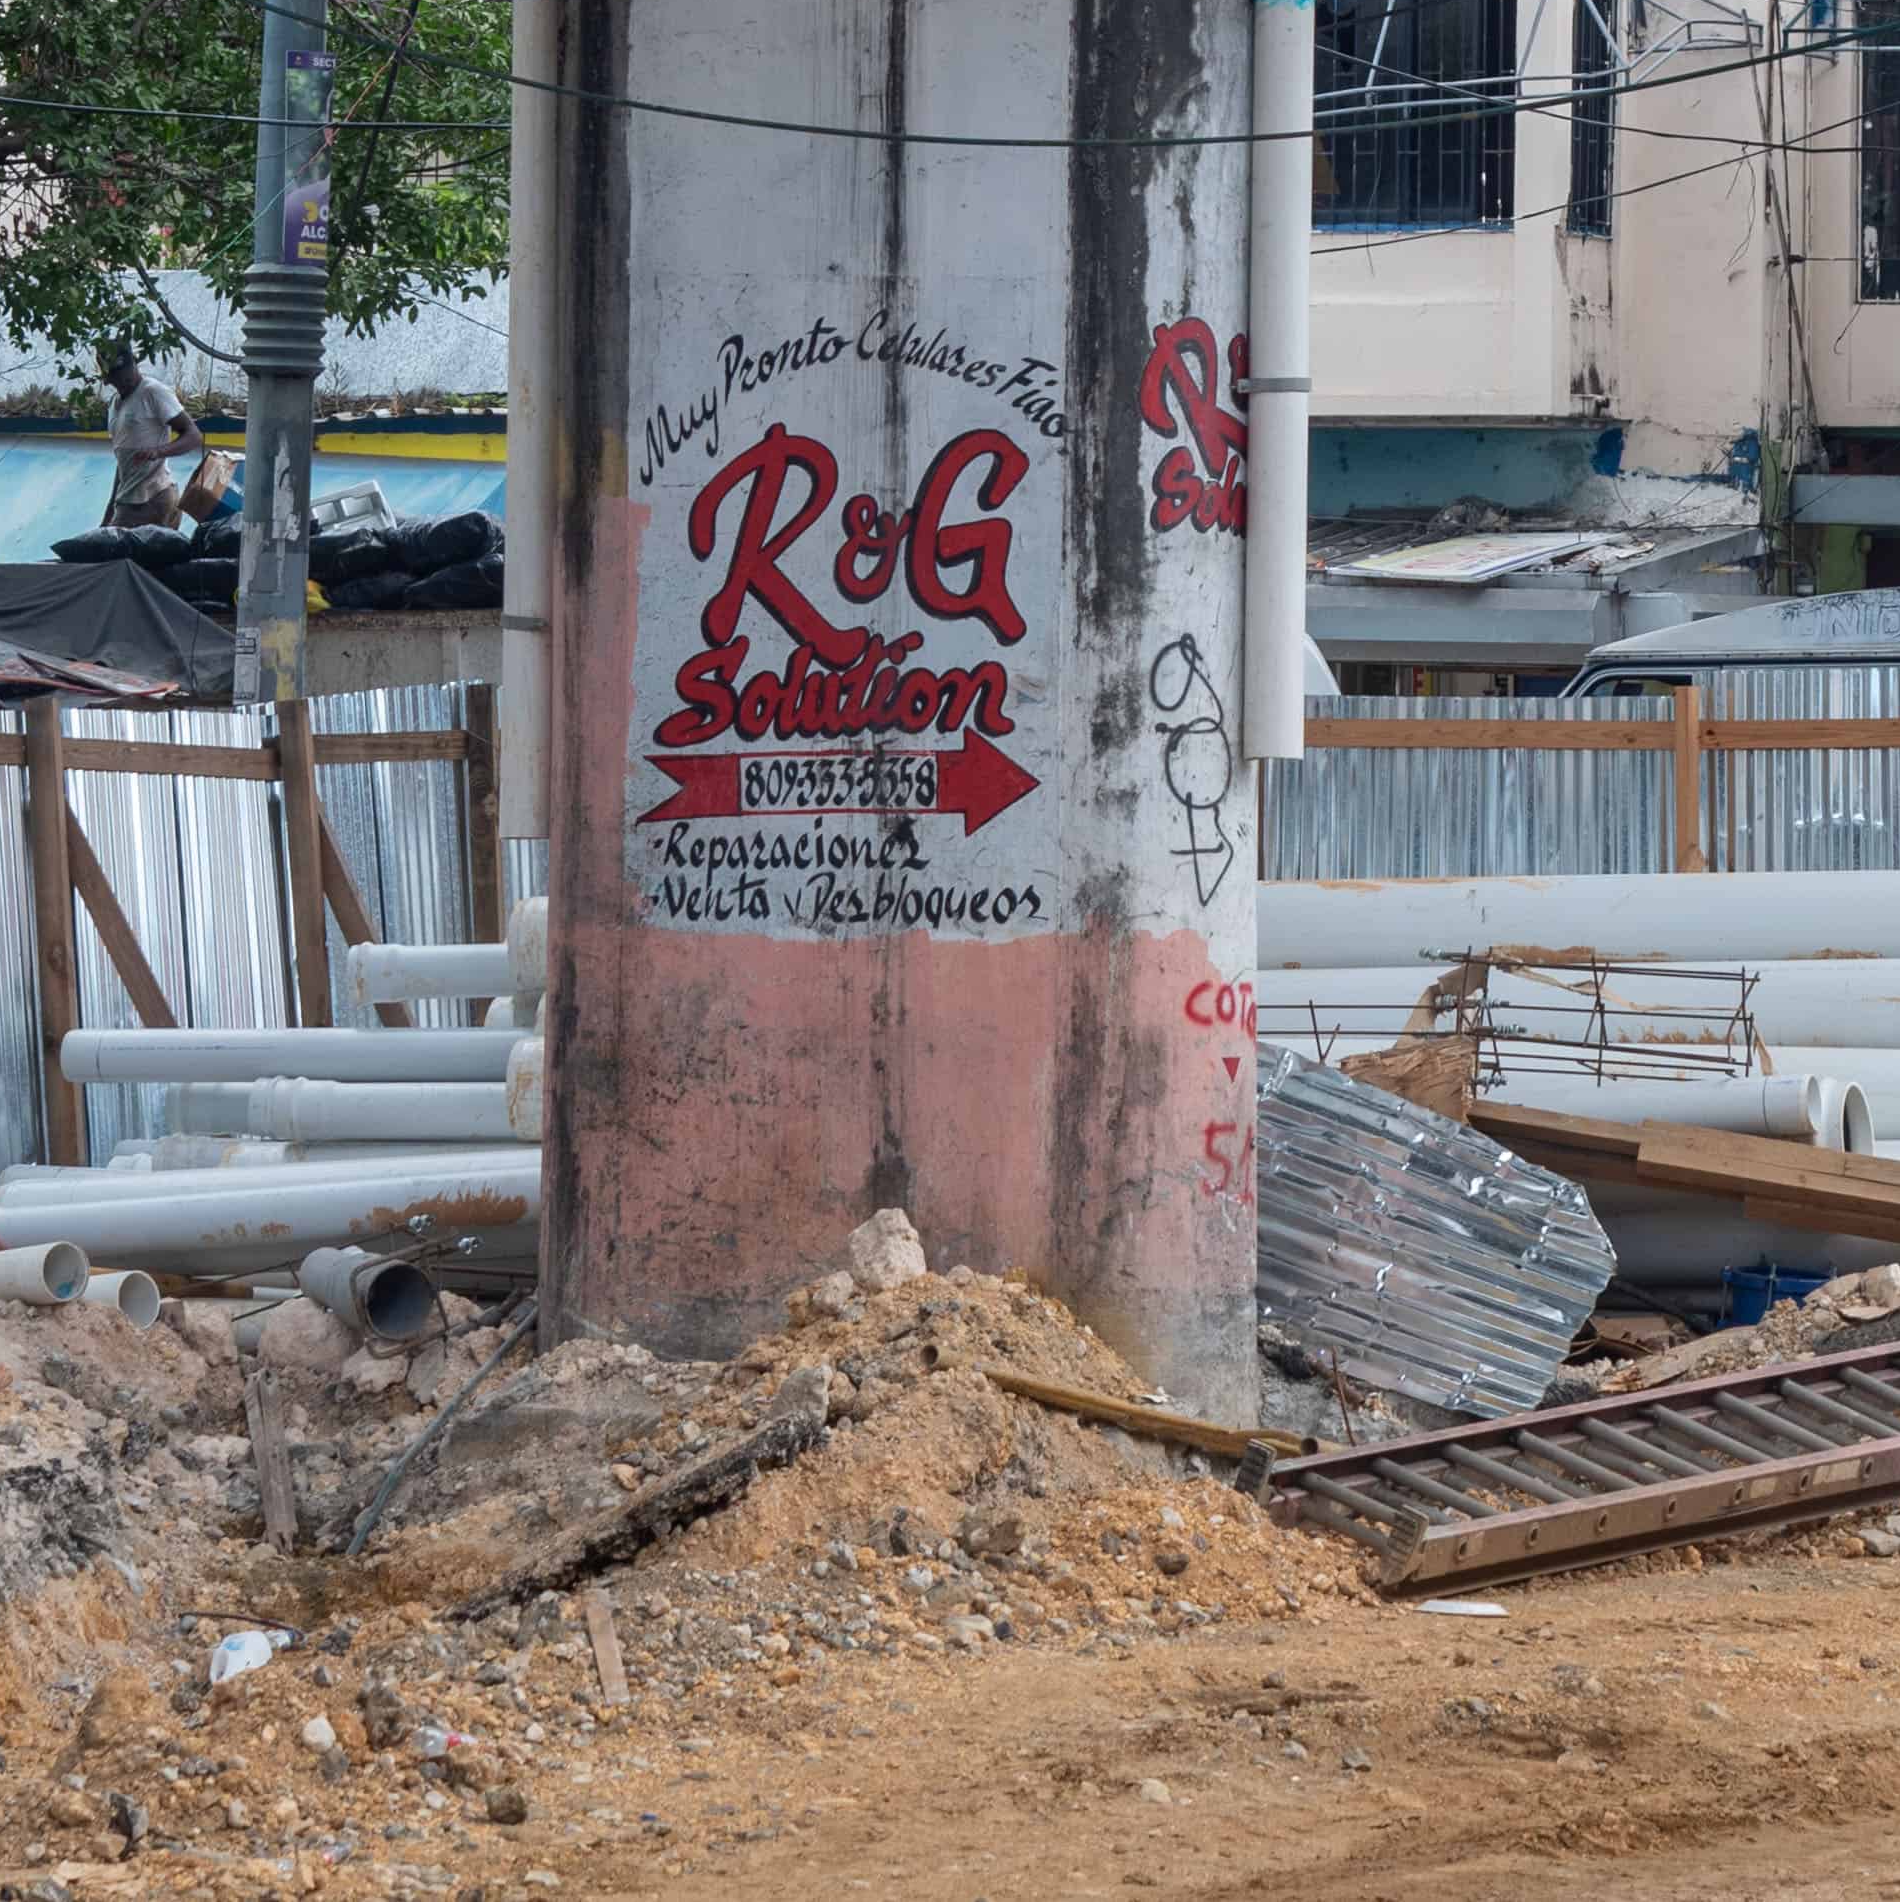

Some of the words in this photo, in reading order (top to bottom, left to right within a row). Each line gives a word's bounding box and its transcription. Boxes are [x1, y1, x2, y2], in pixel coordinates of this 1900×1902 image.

[640, 386, 719, 487] Muy
[717, 317, 851, 406] Pronto
[856, 308, 1008, 388] Celulares
[653, 630, 1017, 747] Solution
[806, 870, 1049, 929] Desbloqueos
